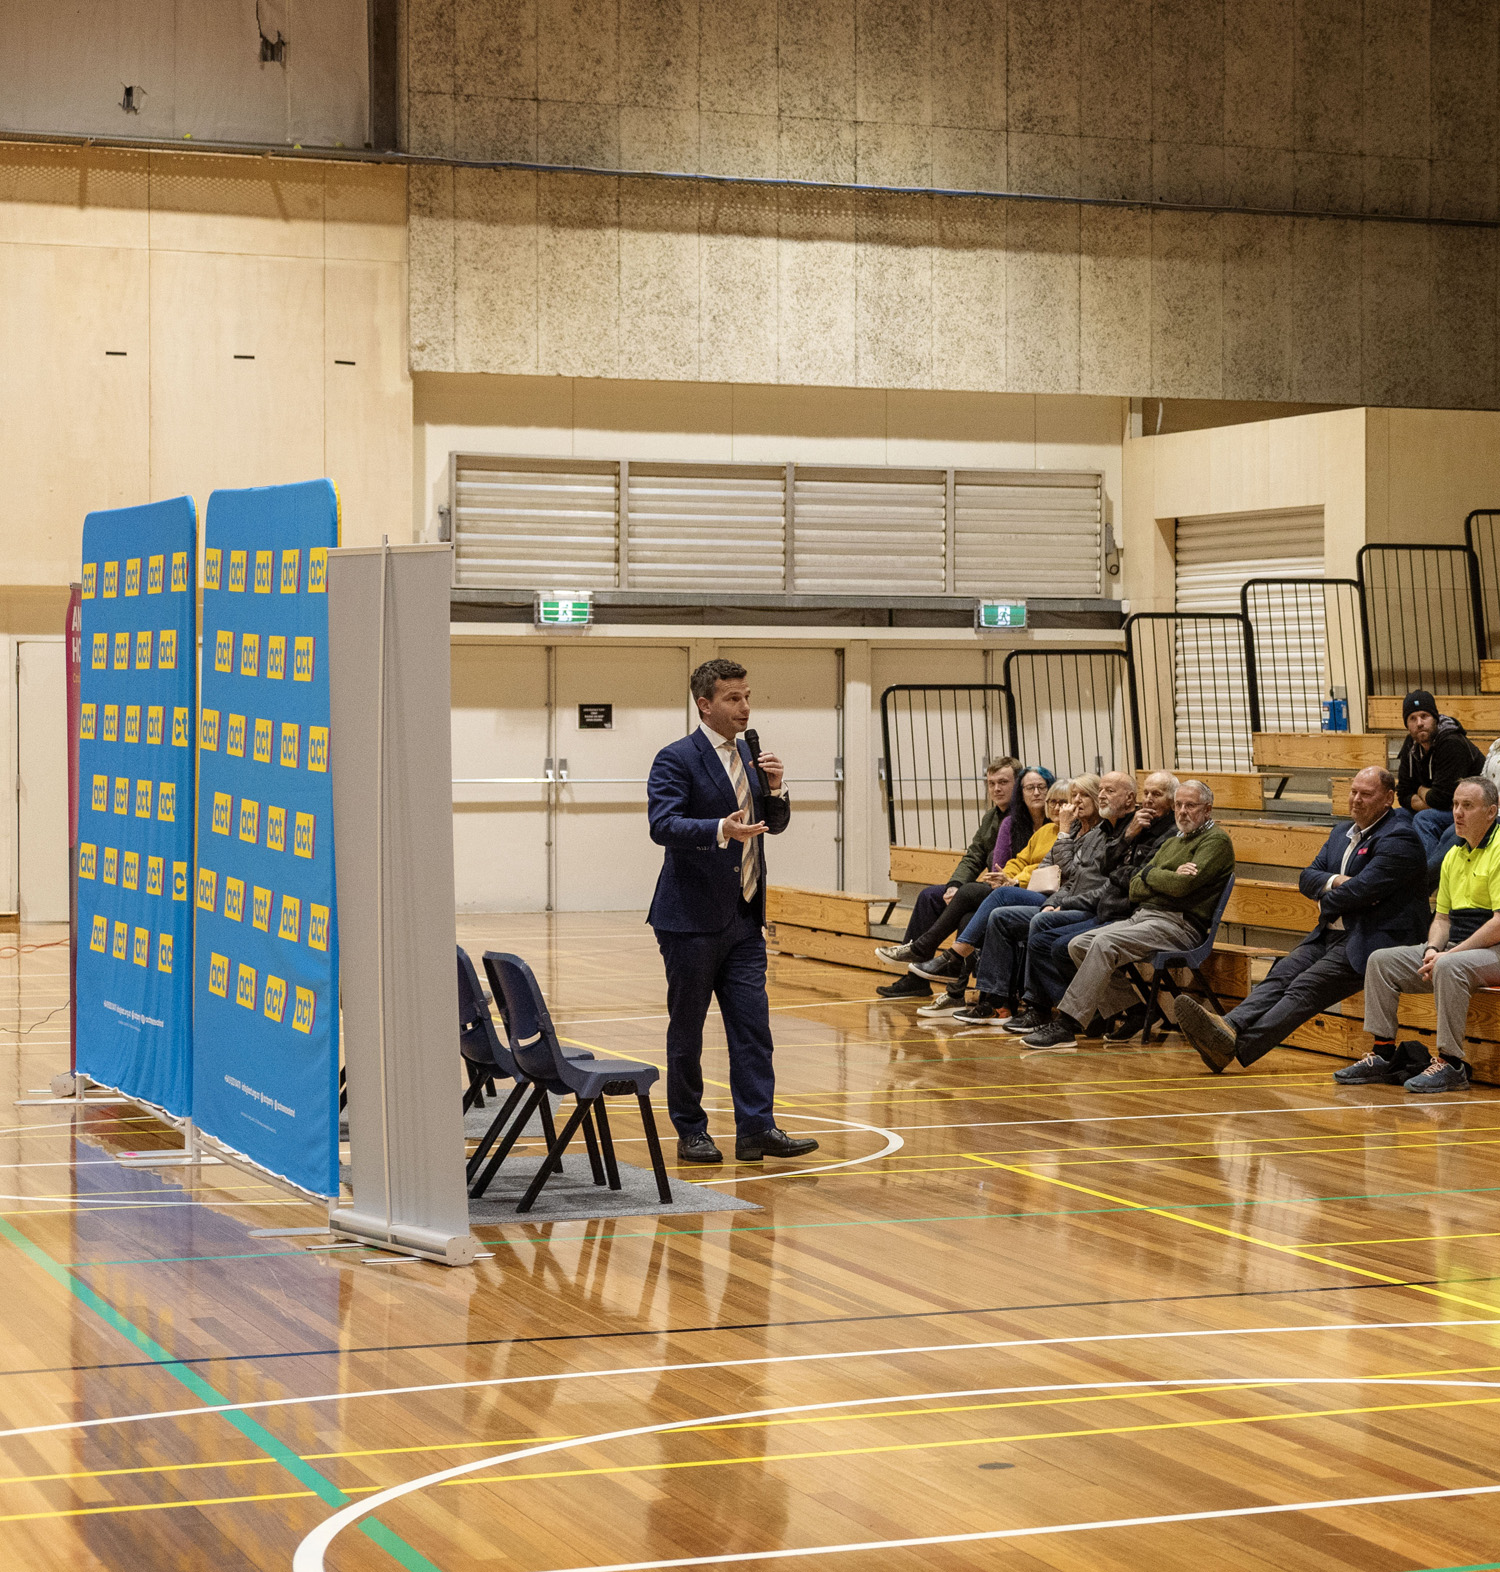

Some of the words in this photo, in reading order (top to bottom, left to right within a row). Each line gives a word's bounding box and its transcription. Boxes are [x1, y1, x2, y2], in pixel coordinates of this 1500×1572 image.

[83, 567, 95, 593] act
[104, 565, 116, 592] act
[126, 563, 138, 590] act
[149, 560, 162, 587] act
[206, 553, 220, 583] act
[231, 556, 245, 586] act
[256, 555, 271, 586] act
[282, 554, 297, 587] act
[310, 552, 327, 586] act
[93, 637, 106, 664] act
[115, 637, 128, 664] act
[137, 635, 150, 663] act
[160, 634, 173, 662] act
[217, 636, 230, 666] act
[243, 640, 256, 669] act
[269, 641, 282, 672] act
[295, 642, 310, 674] act
[81, 708, 94, 733] act
[105, 709, 116, 736] act
[126, 710, 138, 736] act
[174, 712, 188, 741] ct
[202, 716, 216, 744] act
[229, 720, 243, 751] act
[255, 725, 270, 756] act
[282, 729, 297, 761] act
[310, 732, 325, 765] act
[94, 780, 106, 805] act
[116, 783, 127, 809] act
[137, 785, 149, 812] act
[160, 788, 175, 815] act
[214, 799, 229, 829] act
[241, 806, 256, 837] act
[269, 813, 283, 844] act
[295, 819, 311, 852] act
[80, 848, 94, 873] act
[105, 853, 117, 879] act
[125, 857, 136, 884] act
[199, 875, 214, 905] act
[226, 885, 241, 915] act
[254, 894, 267, 925] act
[282, 903, 297, 934] act
[310, 911, 326, 944] act
[93, 921, 105, 947] act
[160, 944, 172, 967] ac
[211, 961, 226, 991] act
[239, 972, 253, 1003] act
[266, 984, 283, 1015] act
[296, 994, 311, 1026] act
